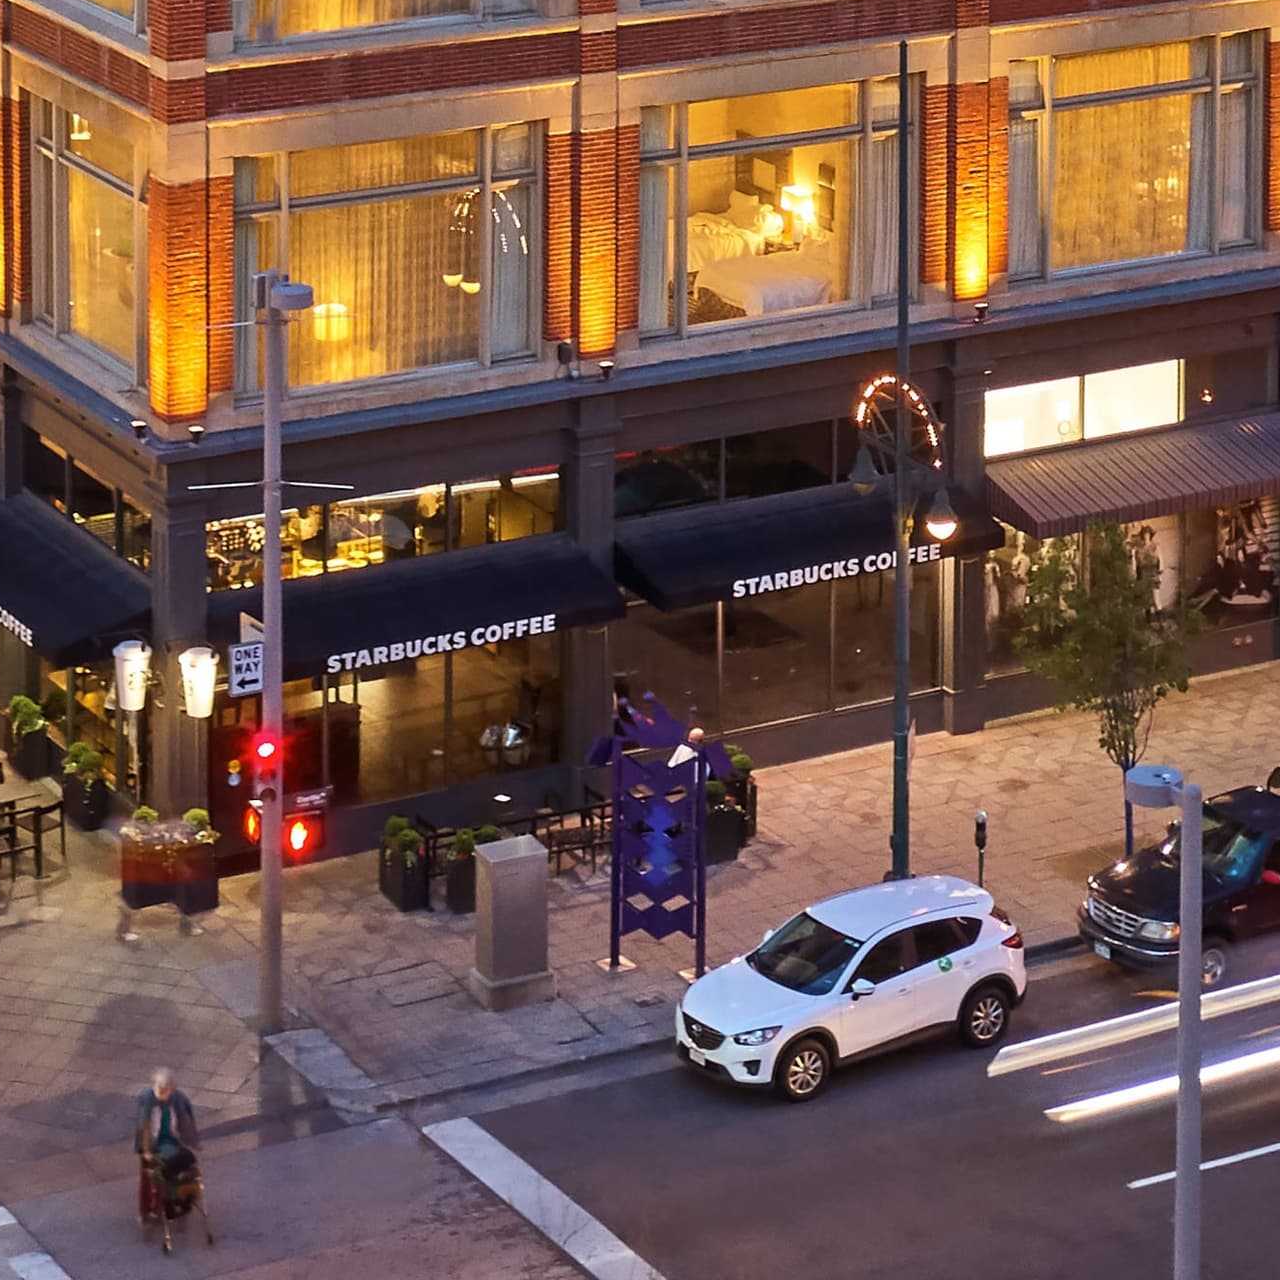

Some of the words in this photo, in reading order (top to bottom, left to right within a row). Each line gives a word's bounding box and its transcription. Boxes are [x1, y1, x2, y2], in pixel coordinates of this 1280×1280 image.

[732, 557, 860, 598] STARBUCKS
[234, 646, 260, 662] ONE
[327, 630, 467, 674] STARBUCKS
[470, 613, 556, 646] COFFEE
[234, 660, 260, 675] WAY
